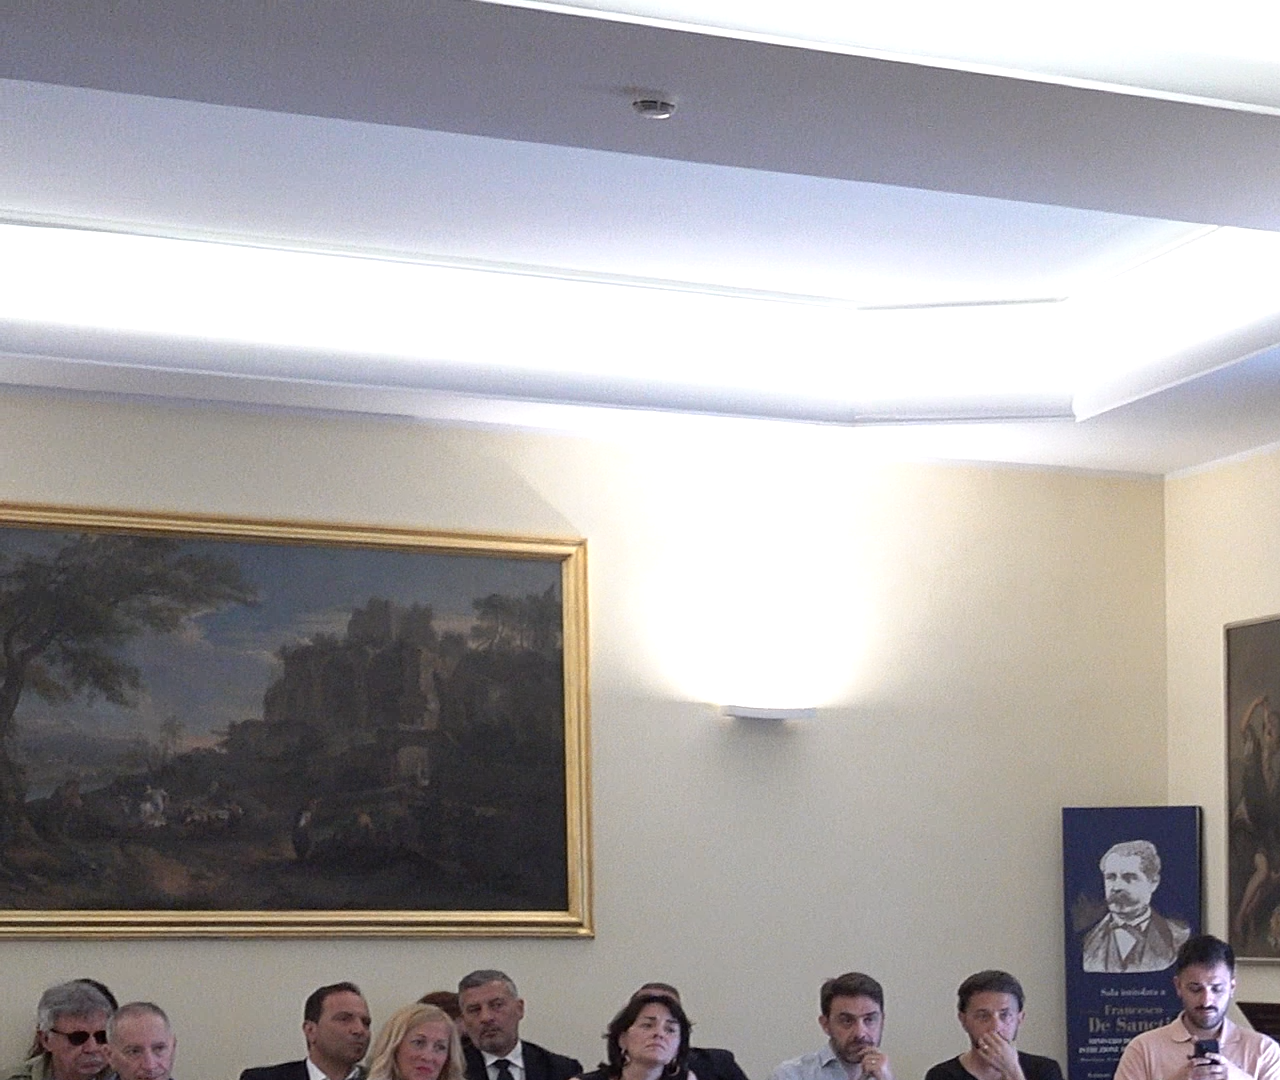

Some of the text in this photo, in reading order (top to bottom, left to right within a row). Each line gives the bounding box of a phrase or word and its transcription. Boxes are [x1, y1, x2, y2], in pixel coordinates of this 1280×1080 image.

[1104, 1004, 1164, 1015] Francesco
[1088, 1017, 1171, 1032] De Sancti
